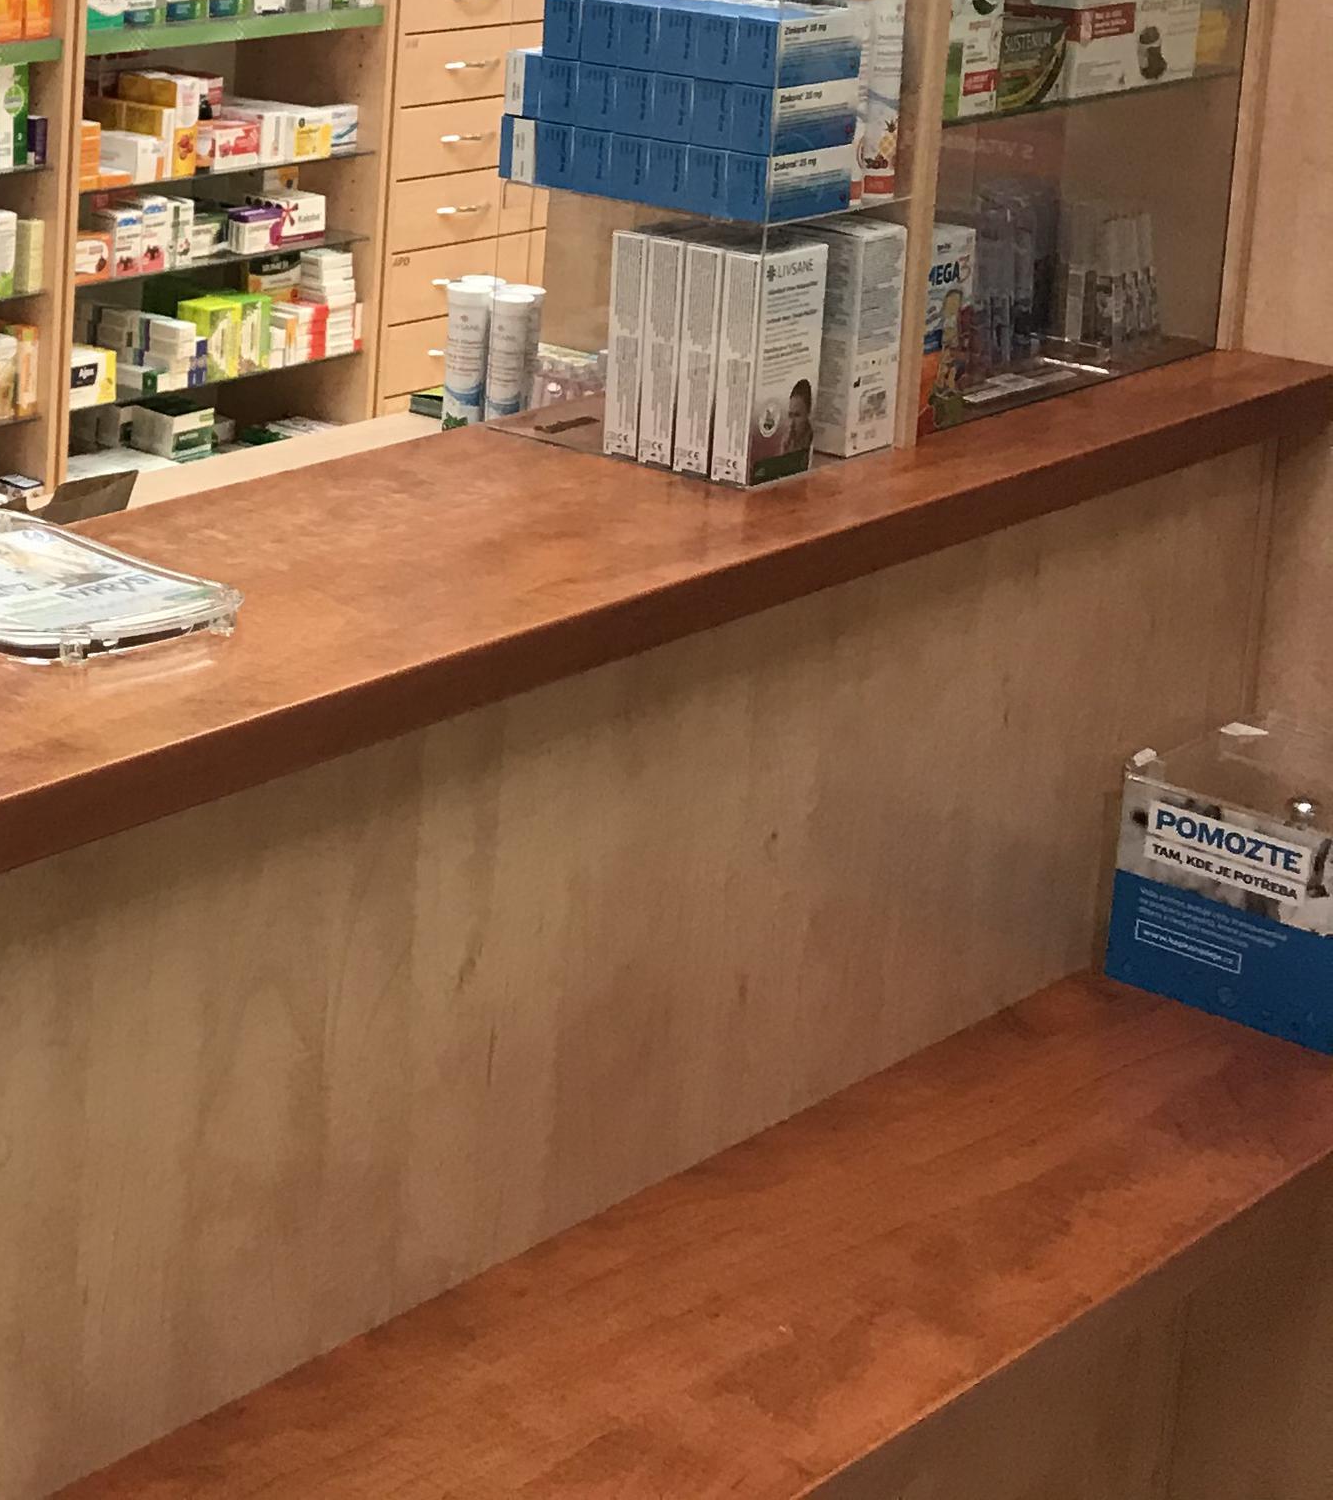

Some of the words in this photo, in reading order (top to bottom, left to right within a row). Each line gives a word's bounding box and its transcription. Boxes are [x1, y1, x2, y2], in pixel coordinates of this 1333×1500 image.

[1153, 843, 1182, 865] TAM,
[1186, 854, 1214, 871] KDE
[1216, 864, 1231, 879] JE
[1234, 868, 1298, 900] POTŘEBA
[1155, 809, 1303, 874] POMOZTE
